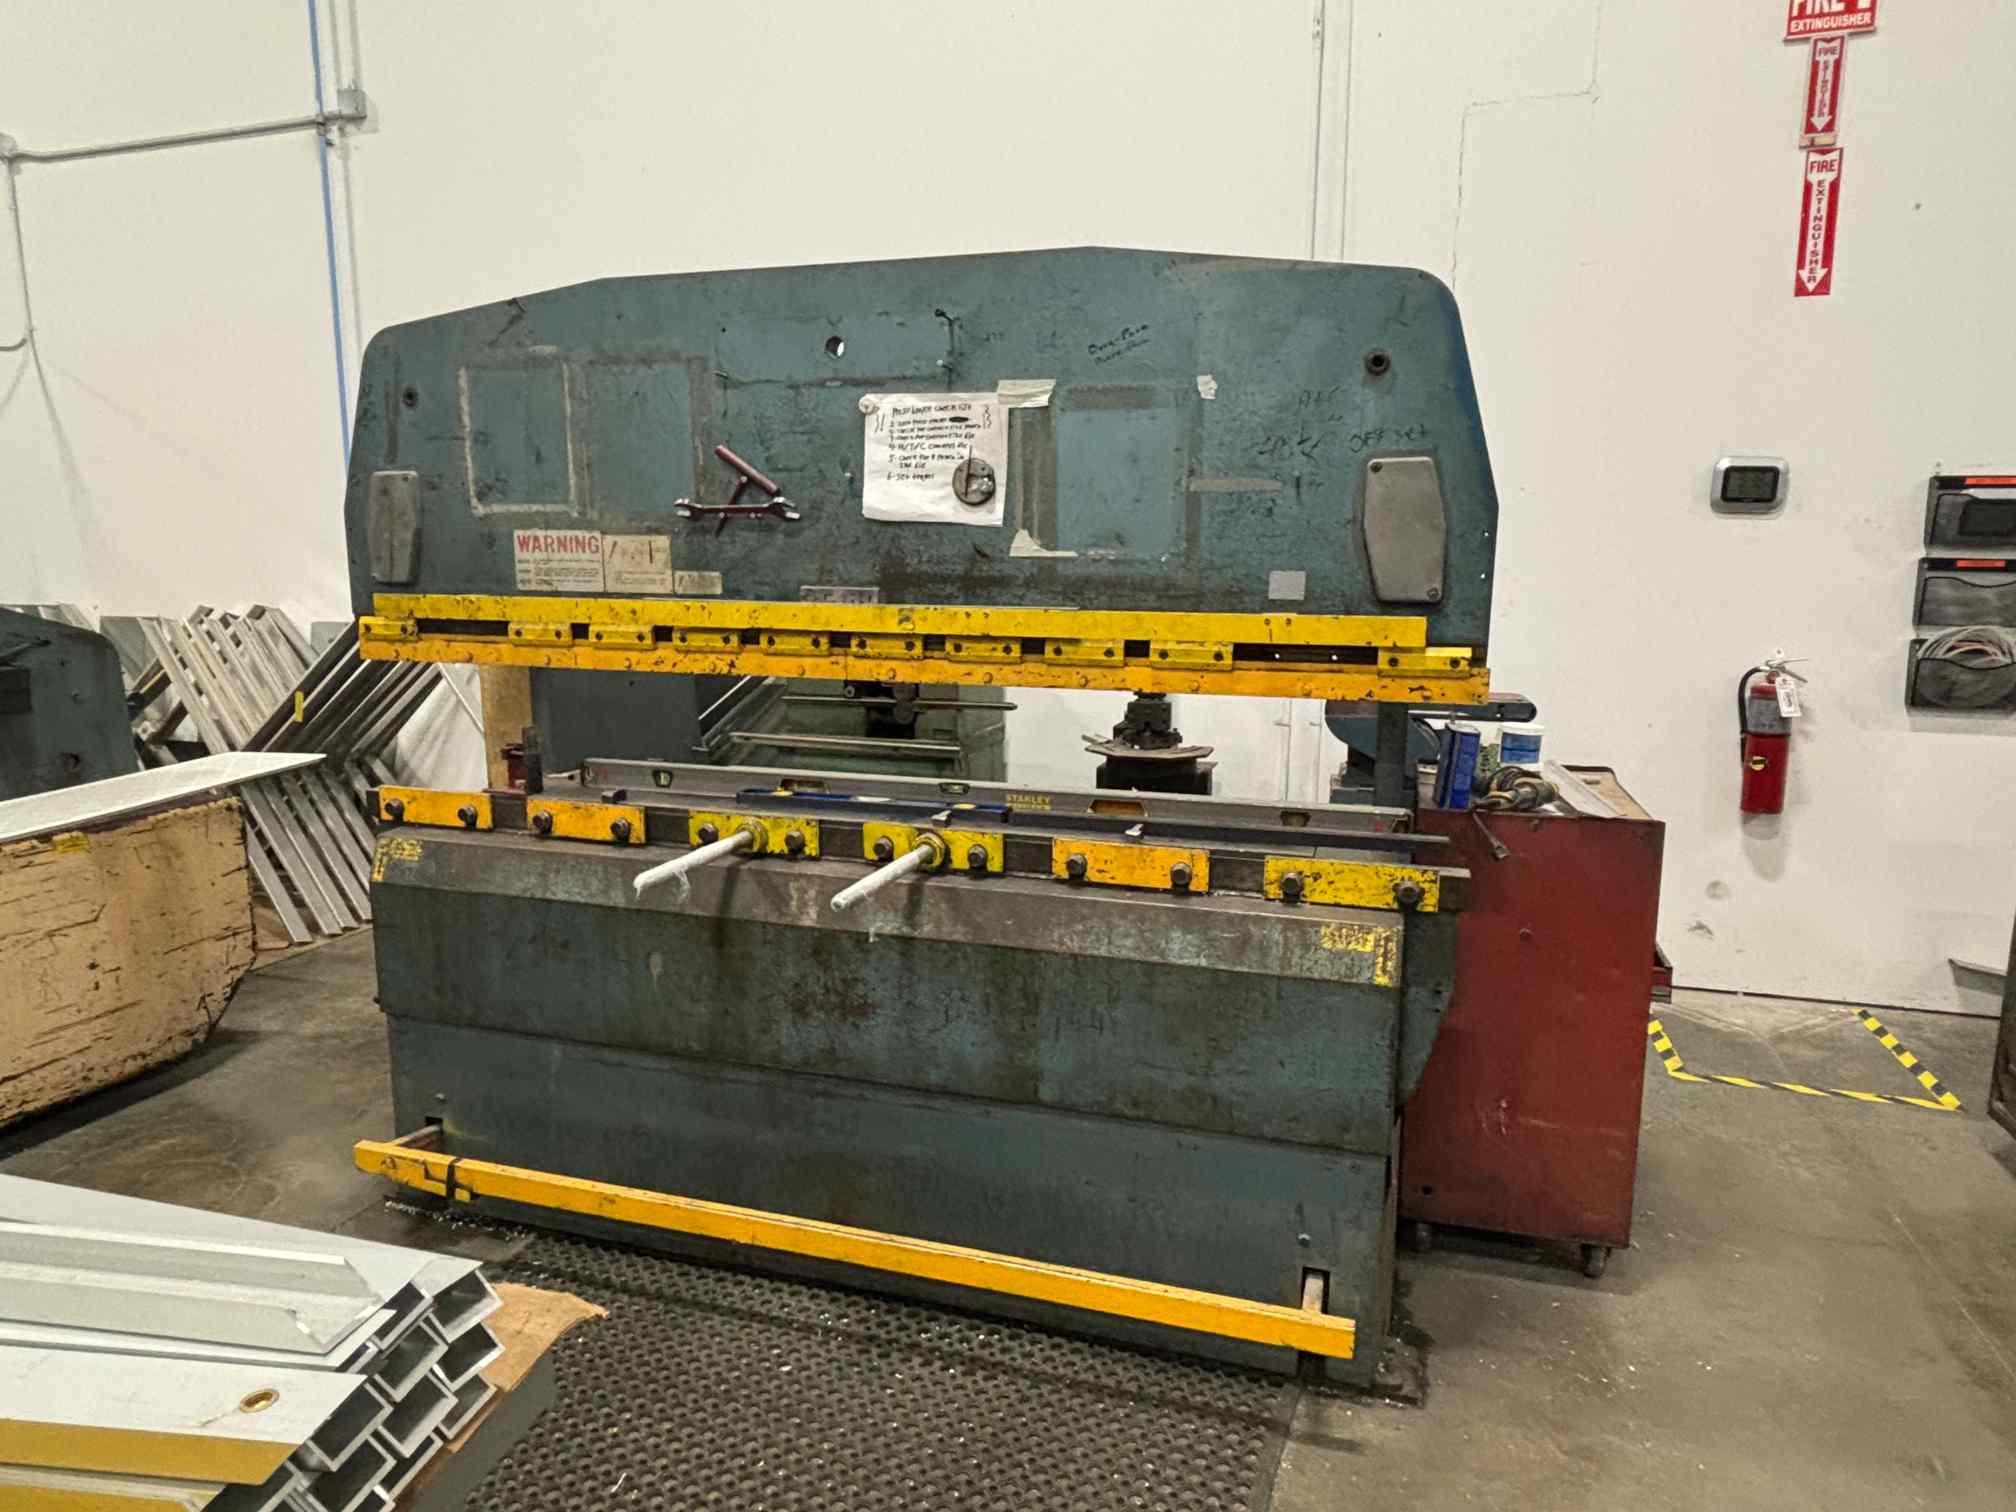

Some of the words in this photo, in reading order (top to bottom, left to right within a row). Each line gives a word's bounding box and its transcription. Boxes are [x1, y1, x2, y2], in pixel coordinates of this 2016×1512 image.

[1790, 12, 1872, 33] EXTINGUISHER
[1818, 46, 1838, 57] FIRE
[1809, 159, 1837, 174] FIRE
[1806, 179, 1826, 283] EXTINGUISHER
[516, 534, 600, 554] WARNING
[1006, 793, 1050, 806] STANLEY
